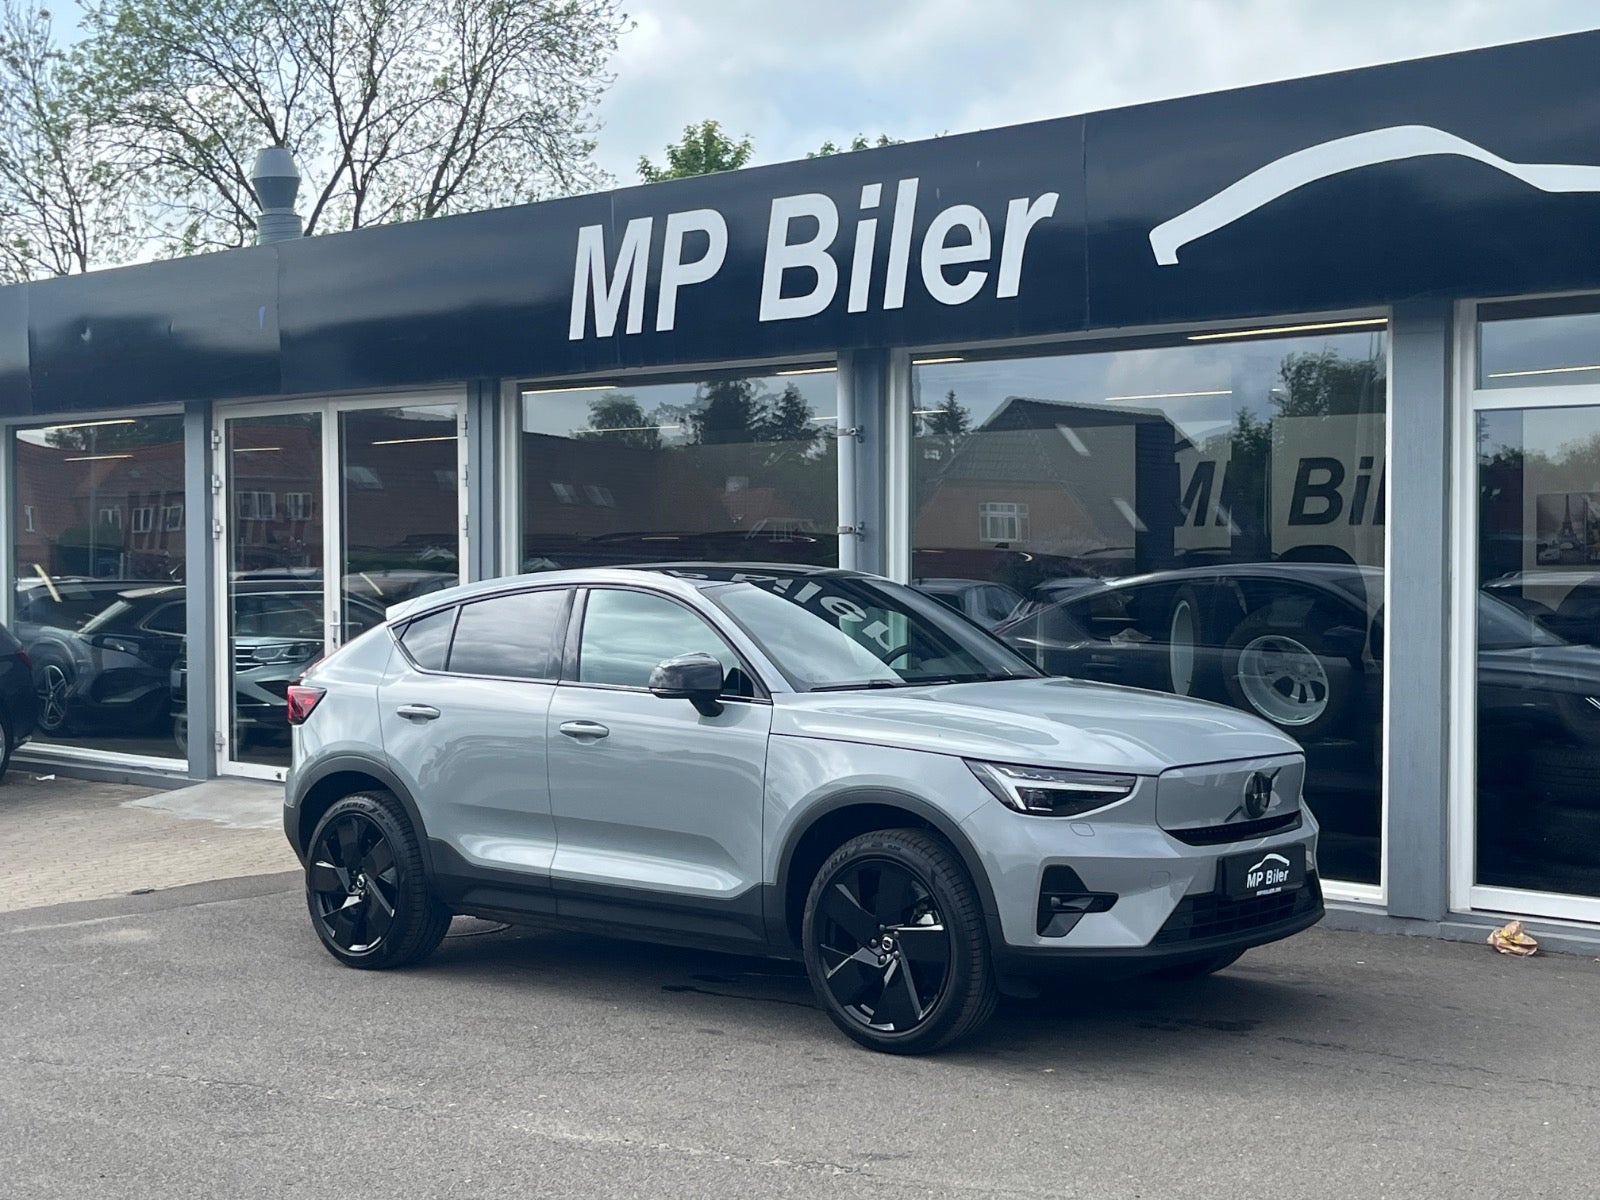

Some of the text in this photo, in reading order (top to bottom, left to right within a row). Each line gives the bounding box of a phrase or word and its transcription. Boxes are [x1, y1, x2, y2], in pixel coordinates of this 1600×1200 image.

[568, 177, 1060, 341] MP Biler
[1246, 868, 1289, 889] MP Biler
